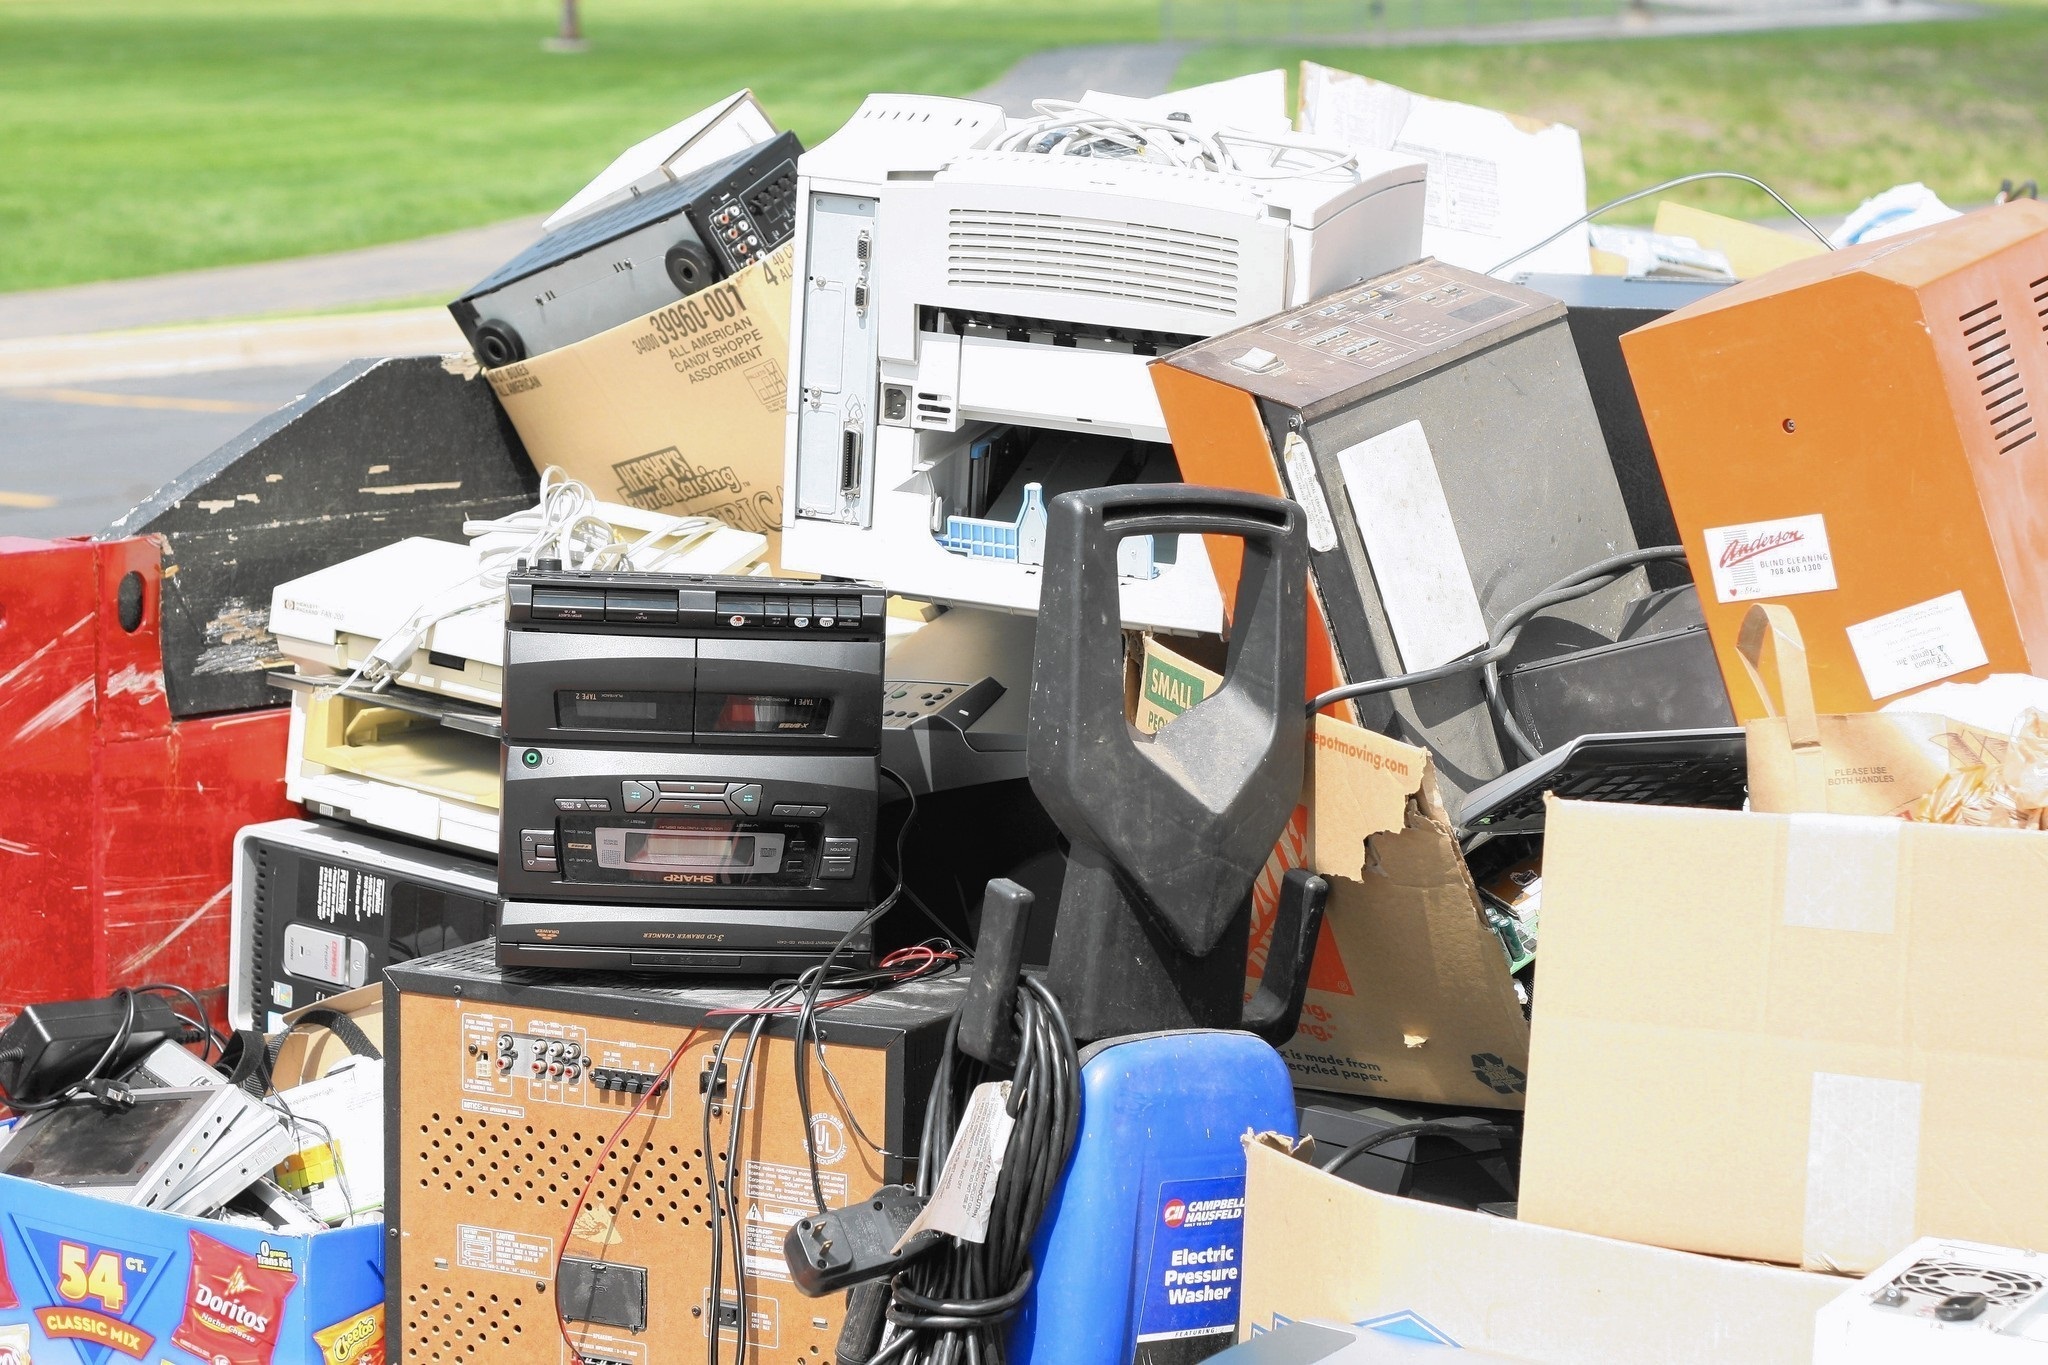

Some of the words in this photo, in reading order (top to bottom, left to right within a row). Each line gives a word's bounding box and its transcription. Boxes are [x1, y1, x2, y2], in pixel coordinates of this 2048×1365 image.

[632, 333, 660, 355] 34000
[650, 282, 747, 345] 39960-001
[668, 344, 691, 360] ALL
[691, 316, 753, 350] AMERICAN
[674, 350, 711, 373] CANDY
[711, 329, 763, 358] SHOPPE
[688, 345, 763, 384] ASSORTMENT
[616, 449, 690, 493] HERSHEY'S
[1720, 530, 1804, 568] Anderson
[1760, 558, 1783, 569] BLIND
[1787, 553, 1829, 565] CLEANING
[1151, 668, 1192, 709] SMALL
[1828, 776, 1853, 786] BOTH
[1855, 775, 1895, 785] HANDLES
[1834, 767, 1868, 776] PLEASE
[1870, 766, 1887, 774] USE
[664, 875, 714, 883] SHARP
[1290, 1049, 1302, 1059] is
[1305, 1053, 1343, 1066] made
[1346, 1057, 1381, 1072] from
[1342, 1070, 1388, 1084] paper.
[1185, 1208, 1242, 1222] HAUSFELD
[1188, 1198, 1245, 1212] CAMPBELL
[260, 1240, 270, 1257] 0
[1172, 1245, 1234, 1266] Electric
[257, 1254, 279, 1267] Trans
[279, 1257, 292, 1269] Fat
[58, 1242, 126, 1312] 54
[125, 1257, 147, 1273] CT.
[761, 1270, 787, 1278] CORPORATION
[1164, 1267, 1238, 1287] Pressure
[1168, 1285, 1231, 1305] Washer
[196, 1284, 268, 1333] Doritos
[47, 1316, 108, 1336] CLASSIC
[110, 1327, 141, 1350] MIX
[201, 1312, 226, 1330] Nacho
[227, 1326, 257, 1343] Cheese
[334, 1316, 376, 1362] Cheetos
